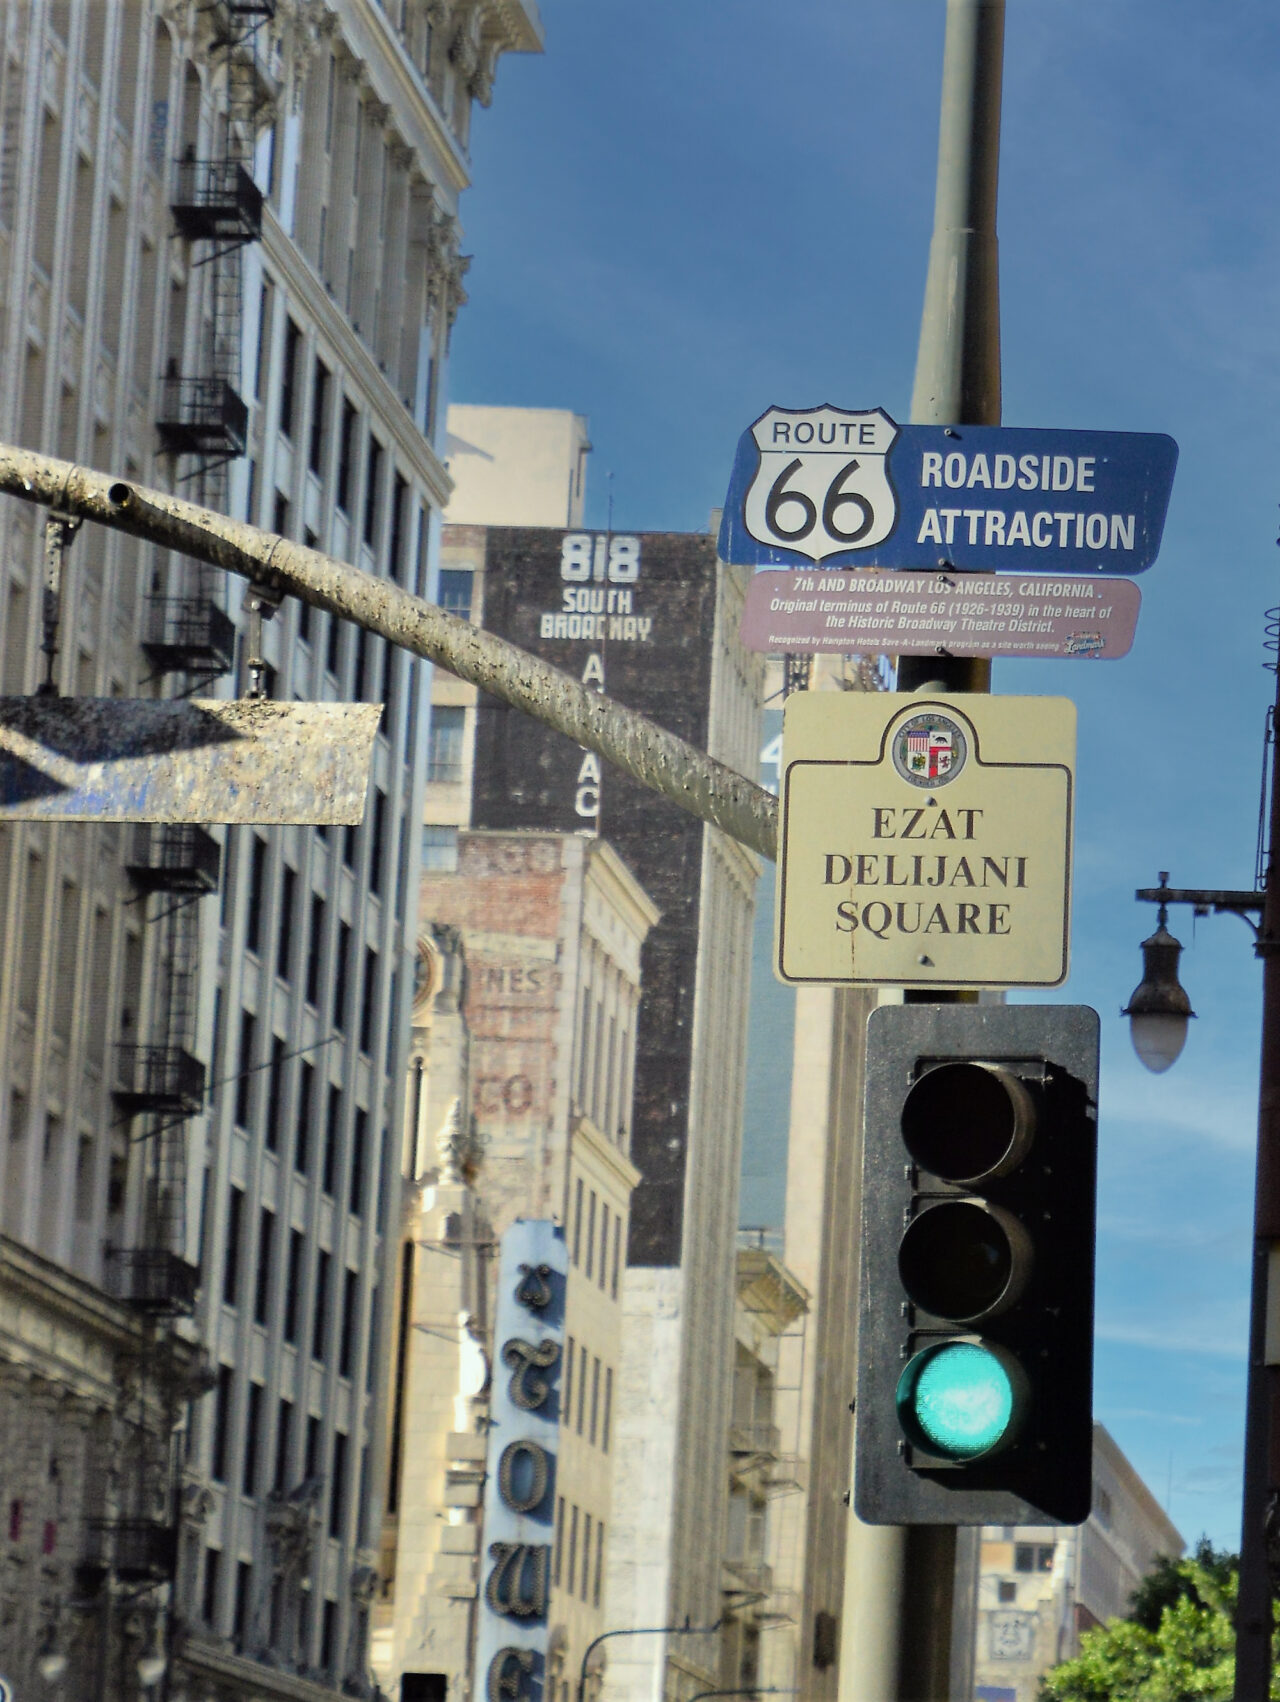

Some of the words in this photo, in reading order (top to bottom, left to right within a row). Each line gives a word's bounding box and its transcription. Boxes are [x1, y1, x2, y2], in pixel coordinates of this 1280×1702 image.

[772, 422, 876, 445] ROUTE
[920, 452, 1096, 493] ROADSIDE
[765, 458, 874, 542] 66
[917, 509, 1136, 550] ATTRACTION
[560, 534, 640, 583] 818
[562, 588, 632, 614] SOUTH
[793, 578, 814, 592] 7th
[818, 578, 845, 592] AND
[849, 579, 925, 594] BROADWAY
[928, 580, 951, 594] LOS
[956, 582, 1014, 598] ANGELES,
[1019, 583, 1094, 598] CALIFORNIA
[770, 598, 817, 615] Original
[819, 599, 872, 613] terminus
[875, 600, 888, 613] of
[891, 601, 928, 614] Route
[930, 601, 946, 614] 66
[948, 601, 1025, 619] (1926-1939)
[1028, 604, 1040, 617] in
[1042, 605, 1061, 618] the
[1064, 605, 1096, 618] heart
[1099, 606, 1113, 619] of
[826, 615, 845, 628] the
[848, 616, 894, 629] Historic
[897, 617, 957, 633] Broadway
[961, 618, 1005, 632] Theatre
[1008, 619, 1055, 633] District.
[541, 613, 652, 641] BROADWAY
[871, 807, 984, 841] EZAT
[823, 854, 1029, 889] DELIJANI
[835, 900, 1012, 940] SQUARE
